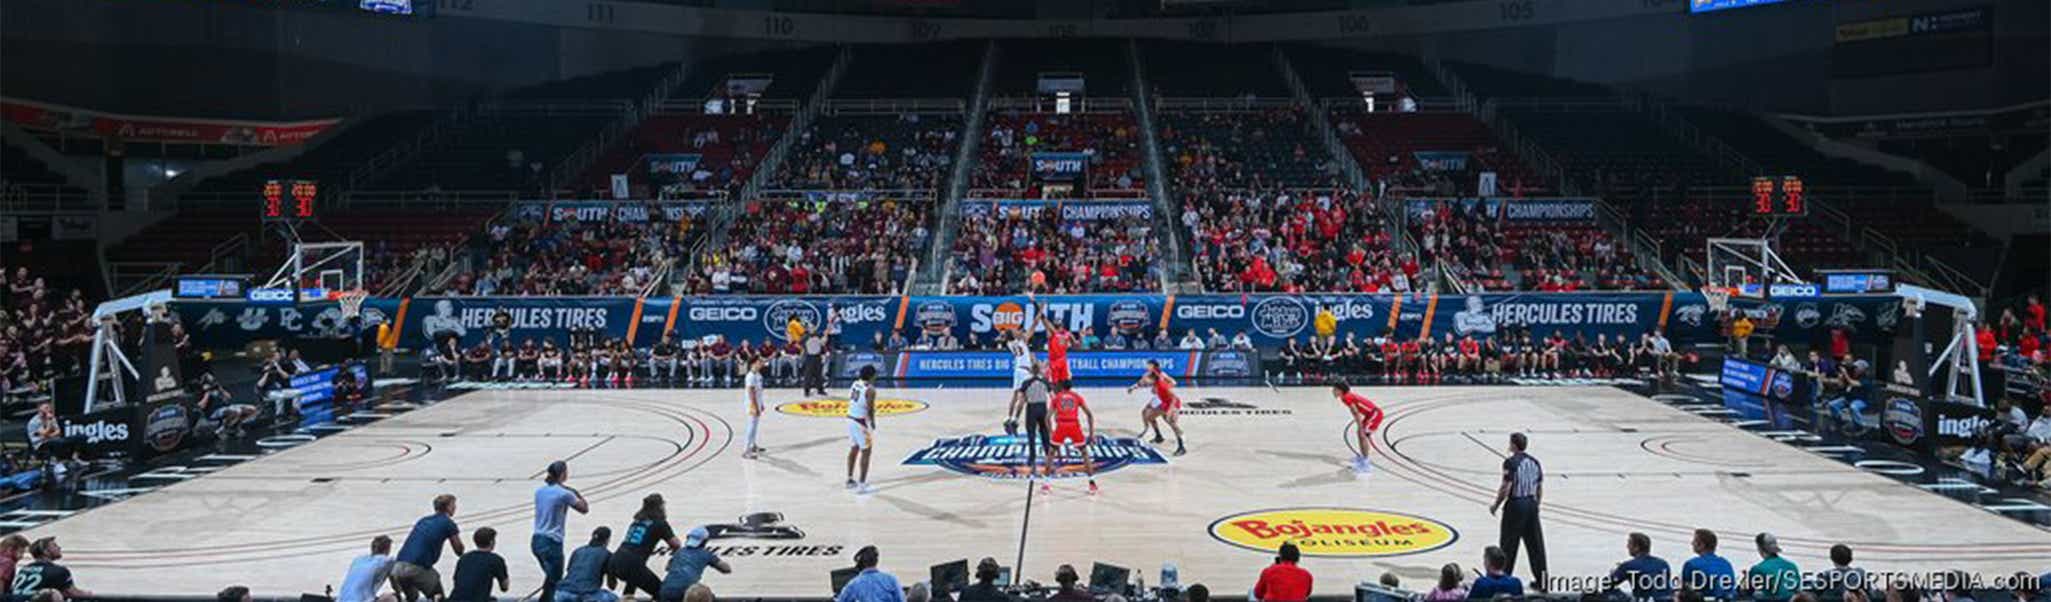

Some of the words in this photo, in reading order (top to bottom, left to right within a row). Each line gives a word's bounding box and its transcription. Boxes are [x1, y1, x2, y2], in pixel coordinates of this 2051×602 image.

[1061, 204, 1151, 220] CHAMPIONSHIPS
[1506, 203, 1594, 219] CHAMPIONSHIPS
[1769, 285, 1816, 297] GEICO
[460, 307, 552, 329] HERULES
[555, 307, 608, 328] TIRES
[689, 307, 757, 321] GEICO
[1177, 304, 1245, 319] GEICO
[1491, 303, 1583, 325] HERCULES
[1585, 303, 1638, 324] TIRES
[919, 359, 963, 370] HERCULES
[64, 419, 129, 443] ingles
[1231, 519, 1432, 540] Bojangles
[761, 546, 845, 557] TIRES
[12, 572, 43, 595] 22
